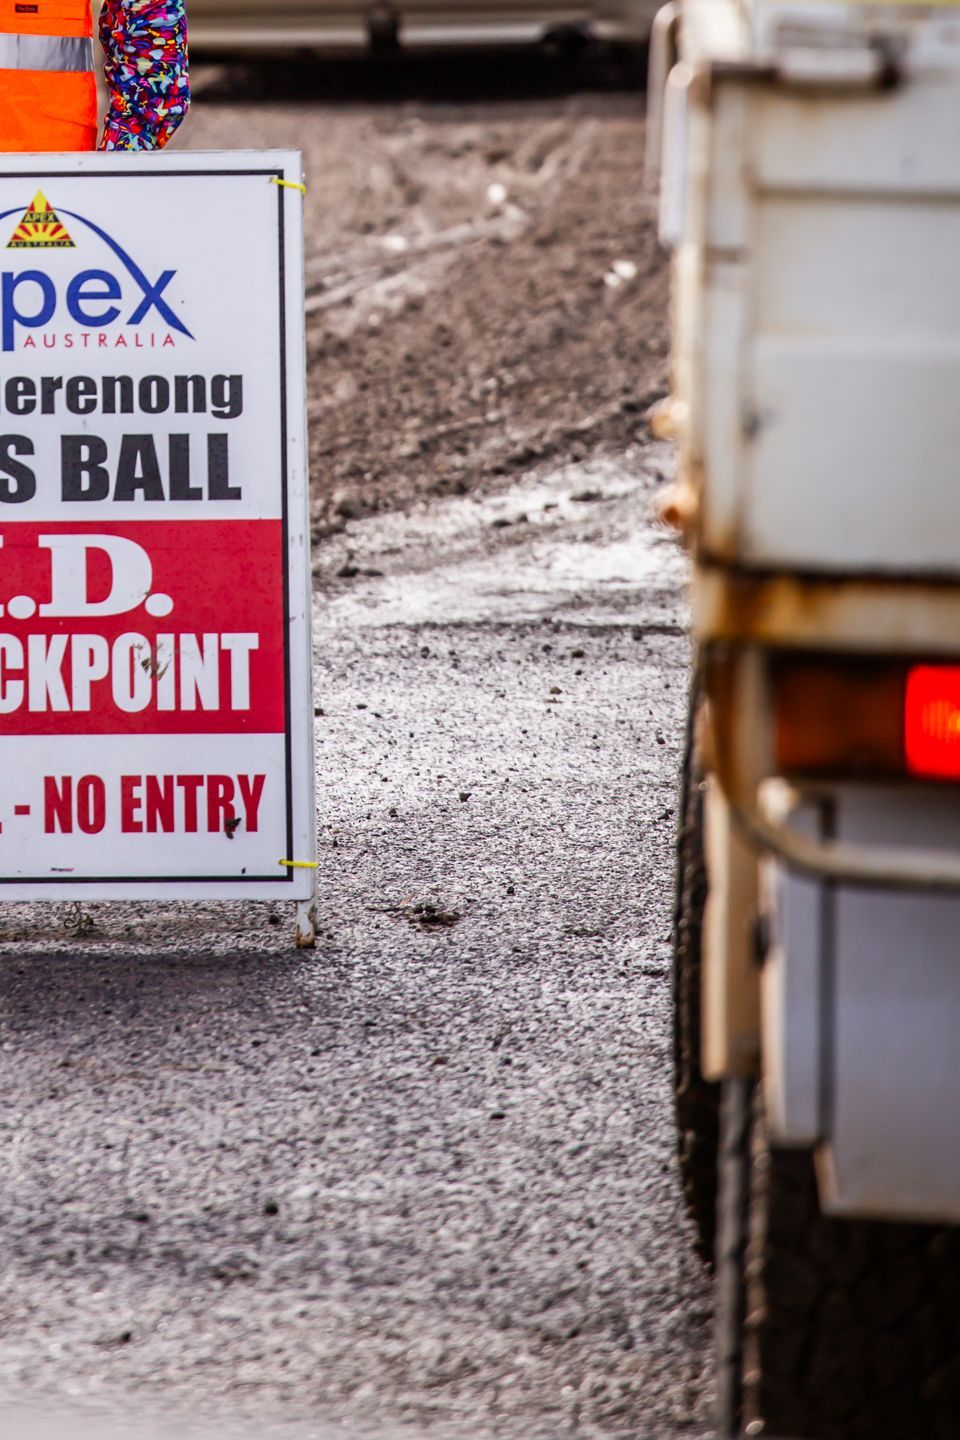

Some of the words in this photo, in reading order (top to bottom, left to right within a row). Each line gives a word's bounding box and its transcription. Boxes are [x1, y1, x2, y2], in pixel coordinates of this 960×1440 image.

[24, 212, 55, 222] APEX
[23, 332, 176, 349] AUSTRALIA
[60, 432, 243, 503] BALL
[43, 775, 107, 835] NO
[119, 773, 268, 838] ENTRY
